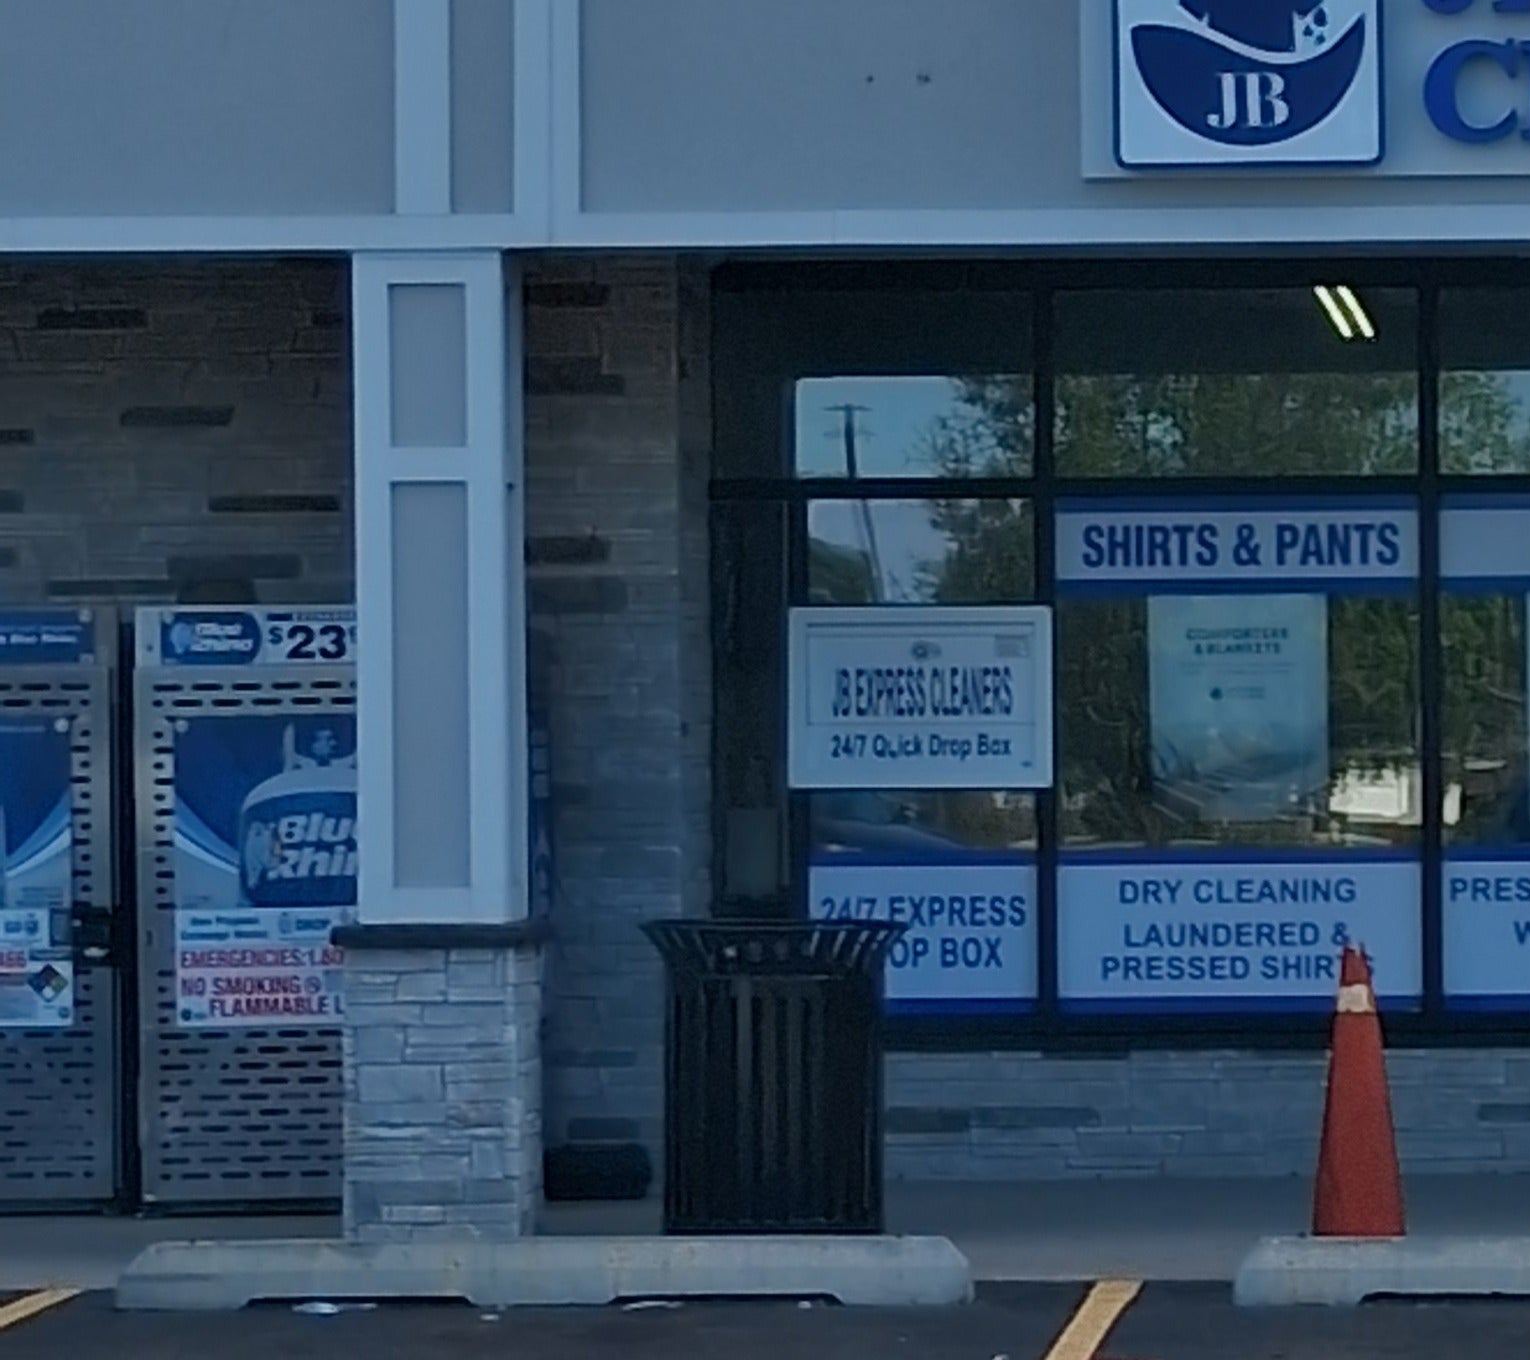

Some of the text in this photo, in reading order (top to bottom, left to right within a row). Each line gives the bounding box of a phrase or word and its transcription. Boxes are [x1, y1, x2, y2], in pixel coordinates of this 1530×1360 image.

[1207, 71, 1290, 130] JB
[1082, 523, 1400, 570] SHIRTS & PANTS
[832, 665, 1014, 717] JB EXPRESS CLEANERS
[831, 733, 1012, 761] 24/7 Quick Drop Box
[278, 812, 357, 843] Blu
[1119, 878, 1357, 905] DRY CLEANING
[888, 895, 1027, 928] EXPRESS
[1123, 922, 1352, 948] LAUNDERED &
[940, 937, 1003, 969] BOX
[1101, 955, 1251, 981] PRESSED
[181, 975, 301, 996] NO SMOKING
[209, 996, 330, 1017] FLAMMABLE
